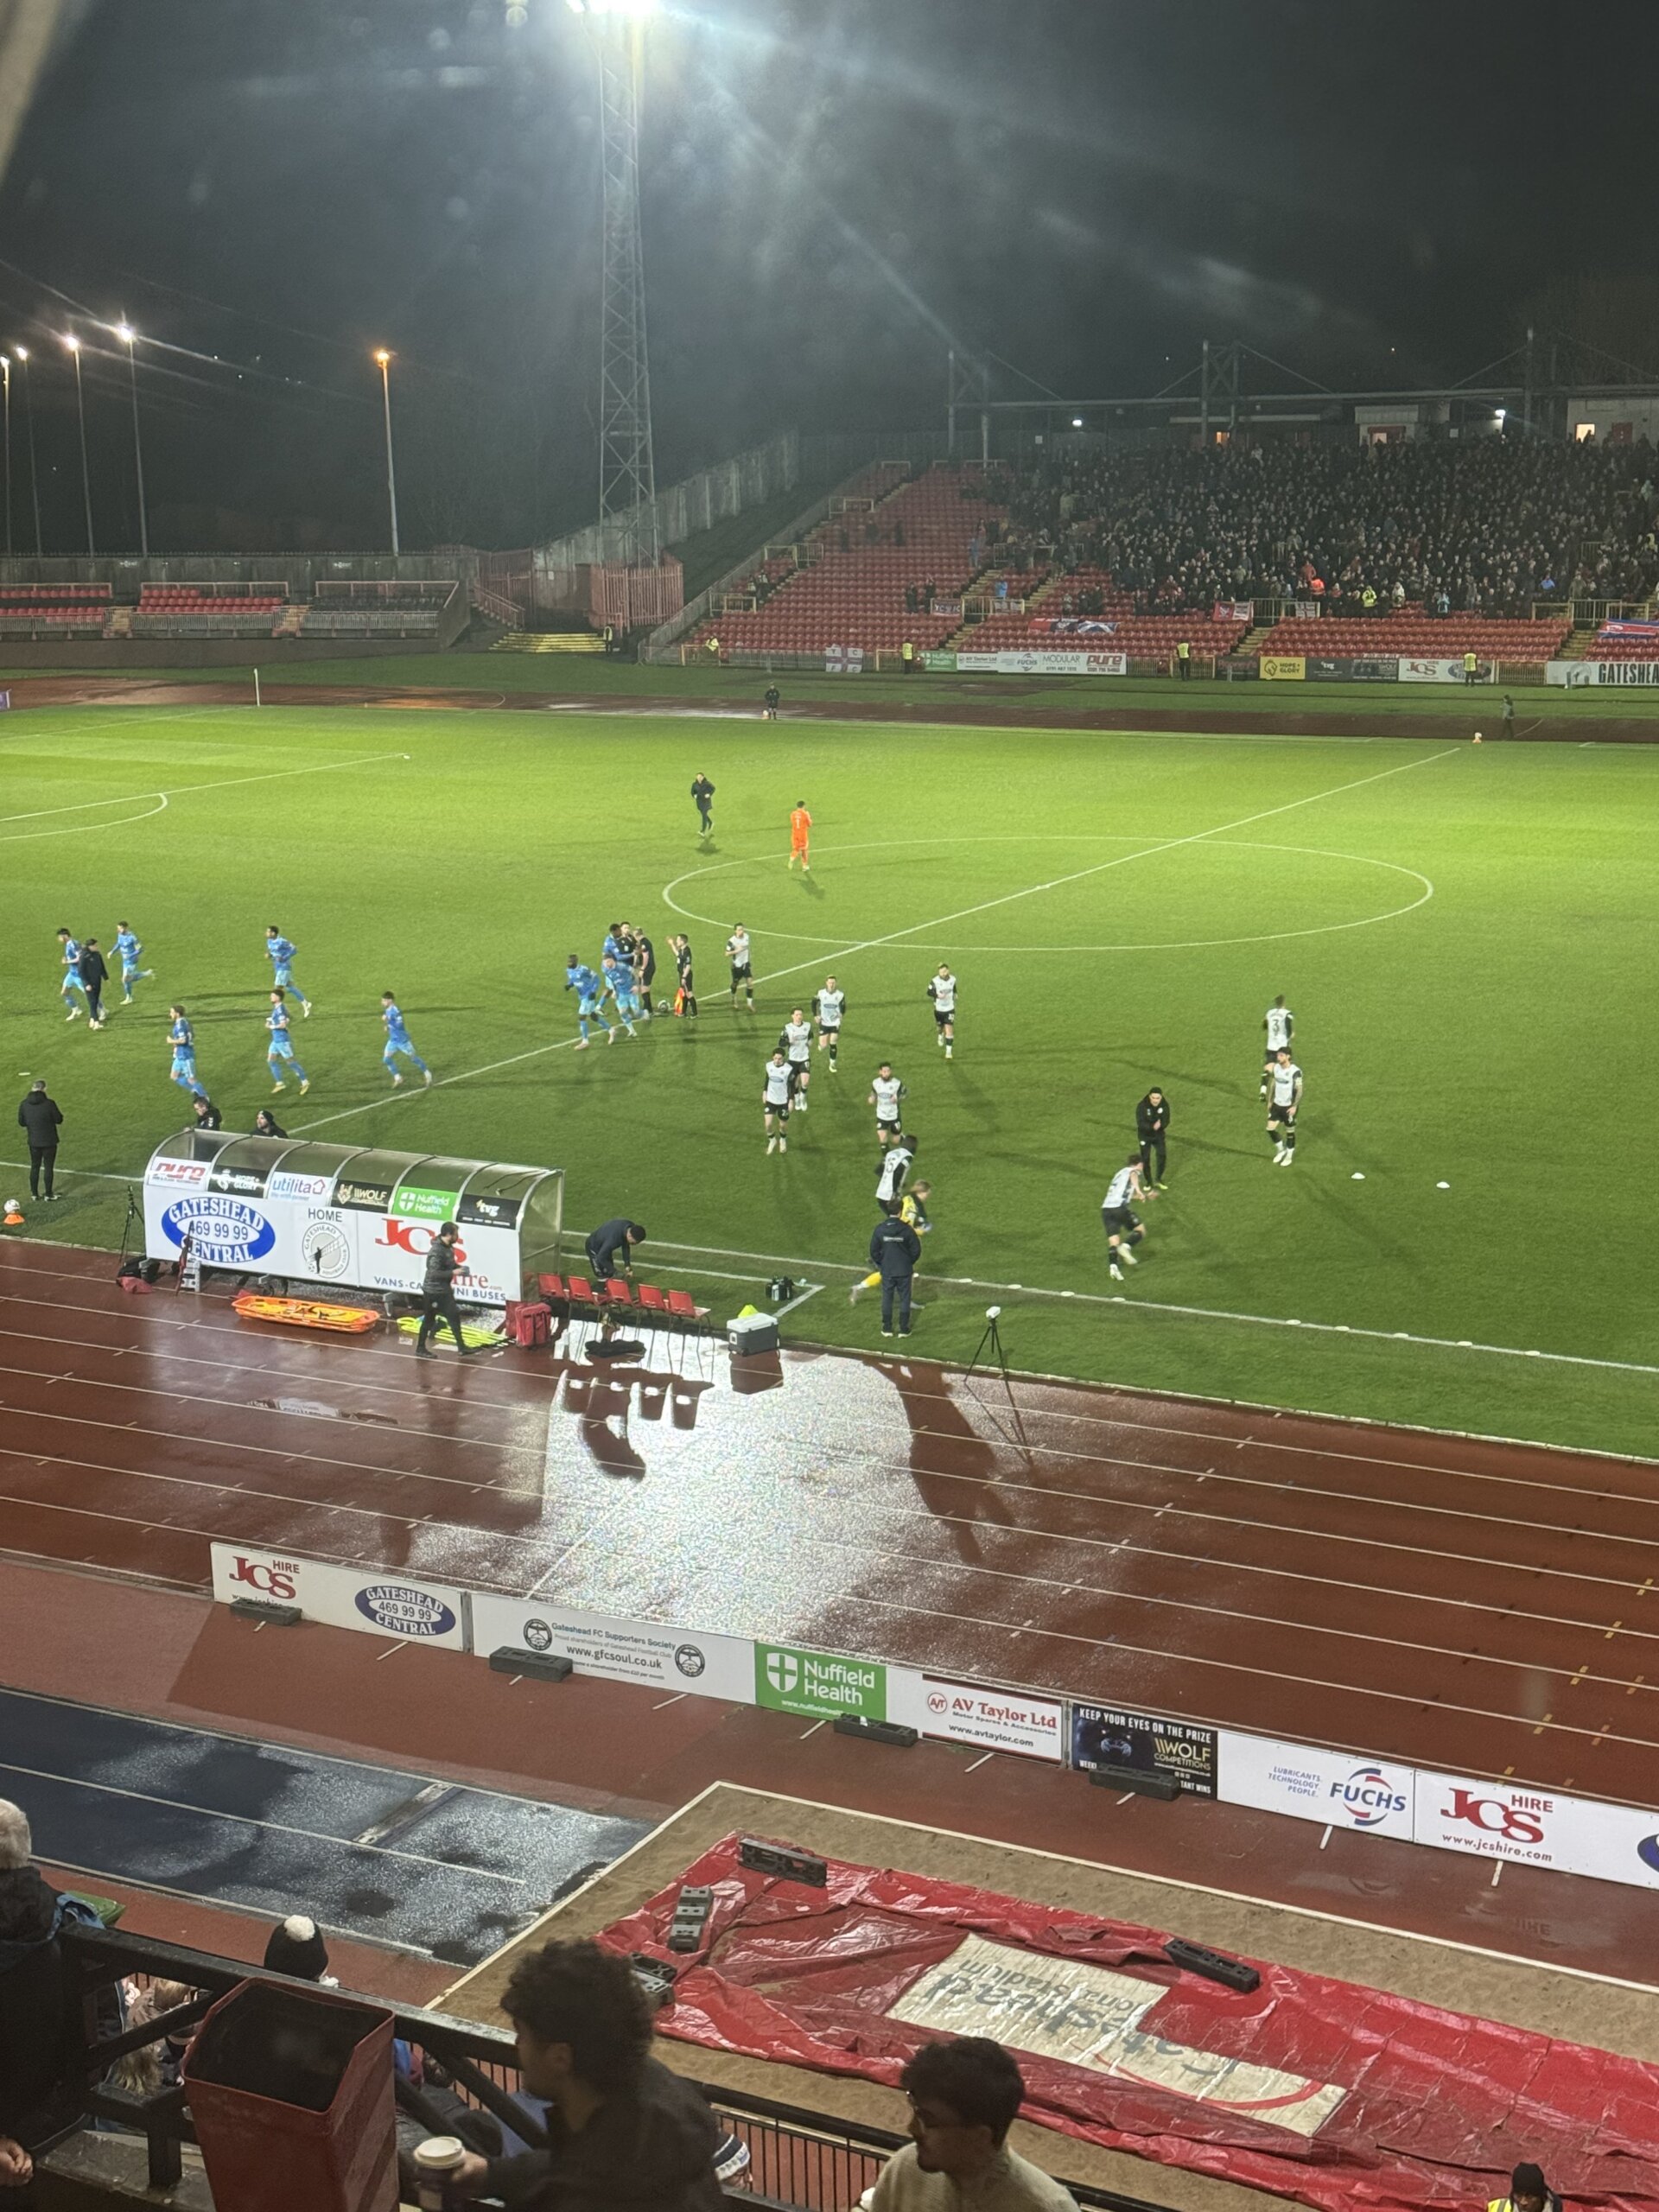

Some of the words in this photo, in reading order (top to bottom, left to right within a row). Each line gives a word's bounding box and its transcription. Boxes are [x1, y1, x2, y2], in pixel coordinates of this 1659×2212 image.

[1042, 654, 1080, 663] MODULAR
[1086, 655, 1122, 665] pure
[272, 1177, 312, 1194] utilita
[415, 1202, 442, 1215] Health
[416, 1193, 450, 1206] Nuffield
[168, 1197, 264, 1232] GATESHEAD
[308, 1207, 343, 1223] HOME
[189, 1220, 210, 1236] 469
[214, 1223, 229, 1238] 99
[233, 1225, 249, 1241] 99
[473, 1289, 506, 1301] BUSES
[228, 1555, 296, 1599] JCS
[272, 1560, 300, 1573] HIRE
[365, 1586, 444, 1613] GATESHEAD
[378, 1601, 398, 1614] 469
[402, 1605, 415, 1618] 99
[418, 1609, 431, 1620] 99
[375, 1612, 435, 1634] CENTRAL
[551, 1623, 591, 1636] Gateshead
[593, 1629, 603, 1637] FC
[605, 1631, 646, 1645] Supporters
[647, 1638, 677, 1651] Society
[567, 1645, 663, 1669] www.gfcsoul.co.uk
[804, 1659, 875, 1689] Nuffield
[804, 1678, 863, 1706] Health
[951, 1697, 975, 1712] AV
[977, 1702, 1027, 1723] Taylor
[1030, 1712, 1058, 1729] Ltd
[952, 1711, 974, 1719] Motor
[976, 1716, 1001, 1726] Spares
[1010, 1723, 1057, 1737] Accessories
[948, 1725, 1034, 1747] www.avtaylor.com
[1079, 1707, 1101, 1721] KEEP
[1103, 1713, 1126, 1726] YOUR
[1128, 1718, 1150, 1732] EYES
[1153, 1723, 1165, 1734] ON
[1166, 1725, 1184, 1738] THE
[1186, 1729, 1211, 1744] PRIZE
[1154, 1738, 1211, 1762] WOLF
[1154, 1752, 1211, 1770] COMPETITIONS
[1329, 1782, 1407, 1812] FUCHS
[1440, 1787, 1545, 1844] JCS
[1511, 1794, 1554, 1814] HIRE
[1442, 1834, 1553, 1863] www.jcshire.com
